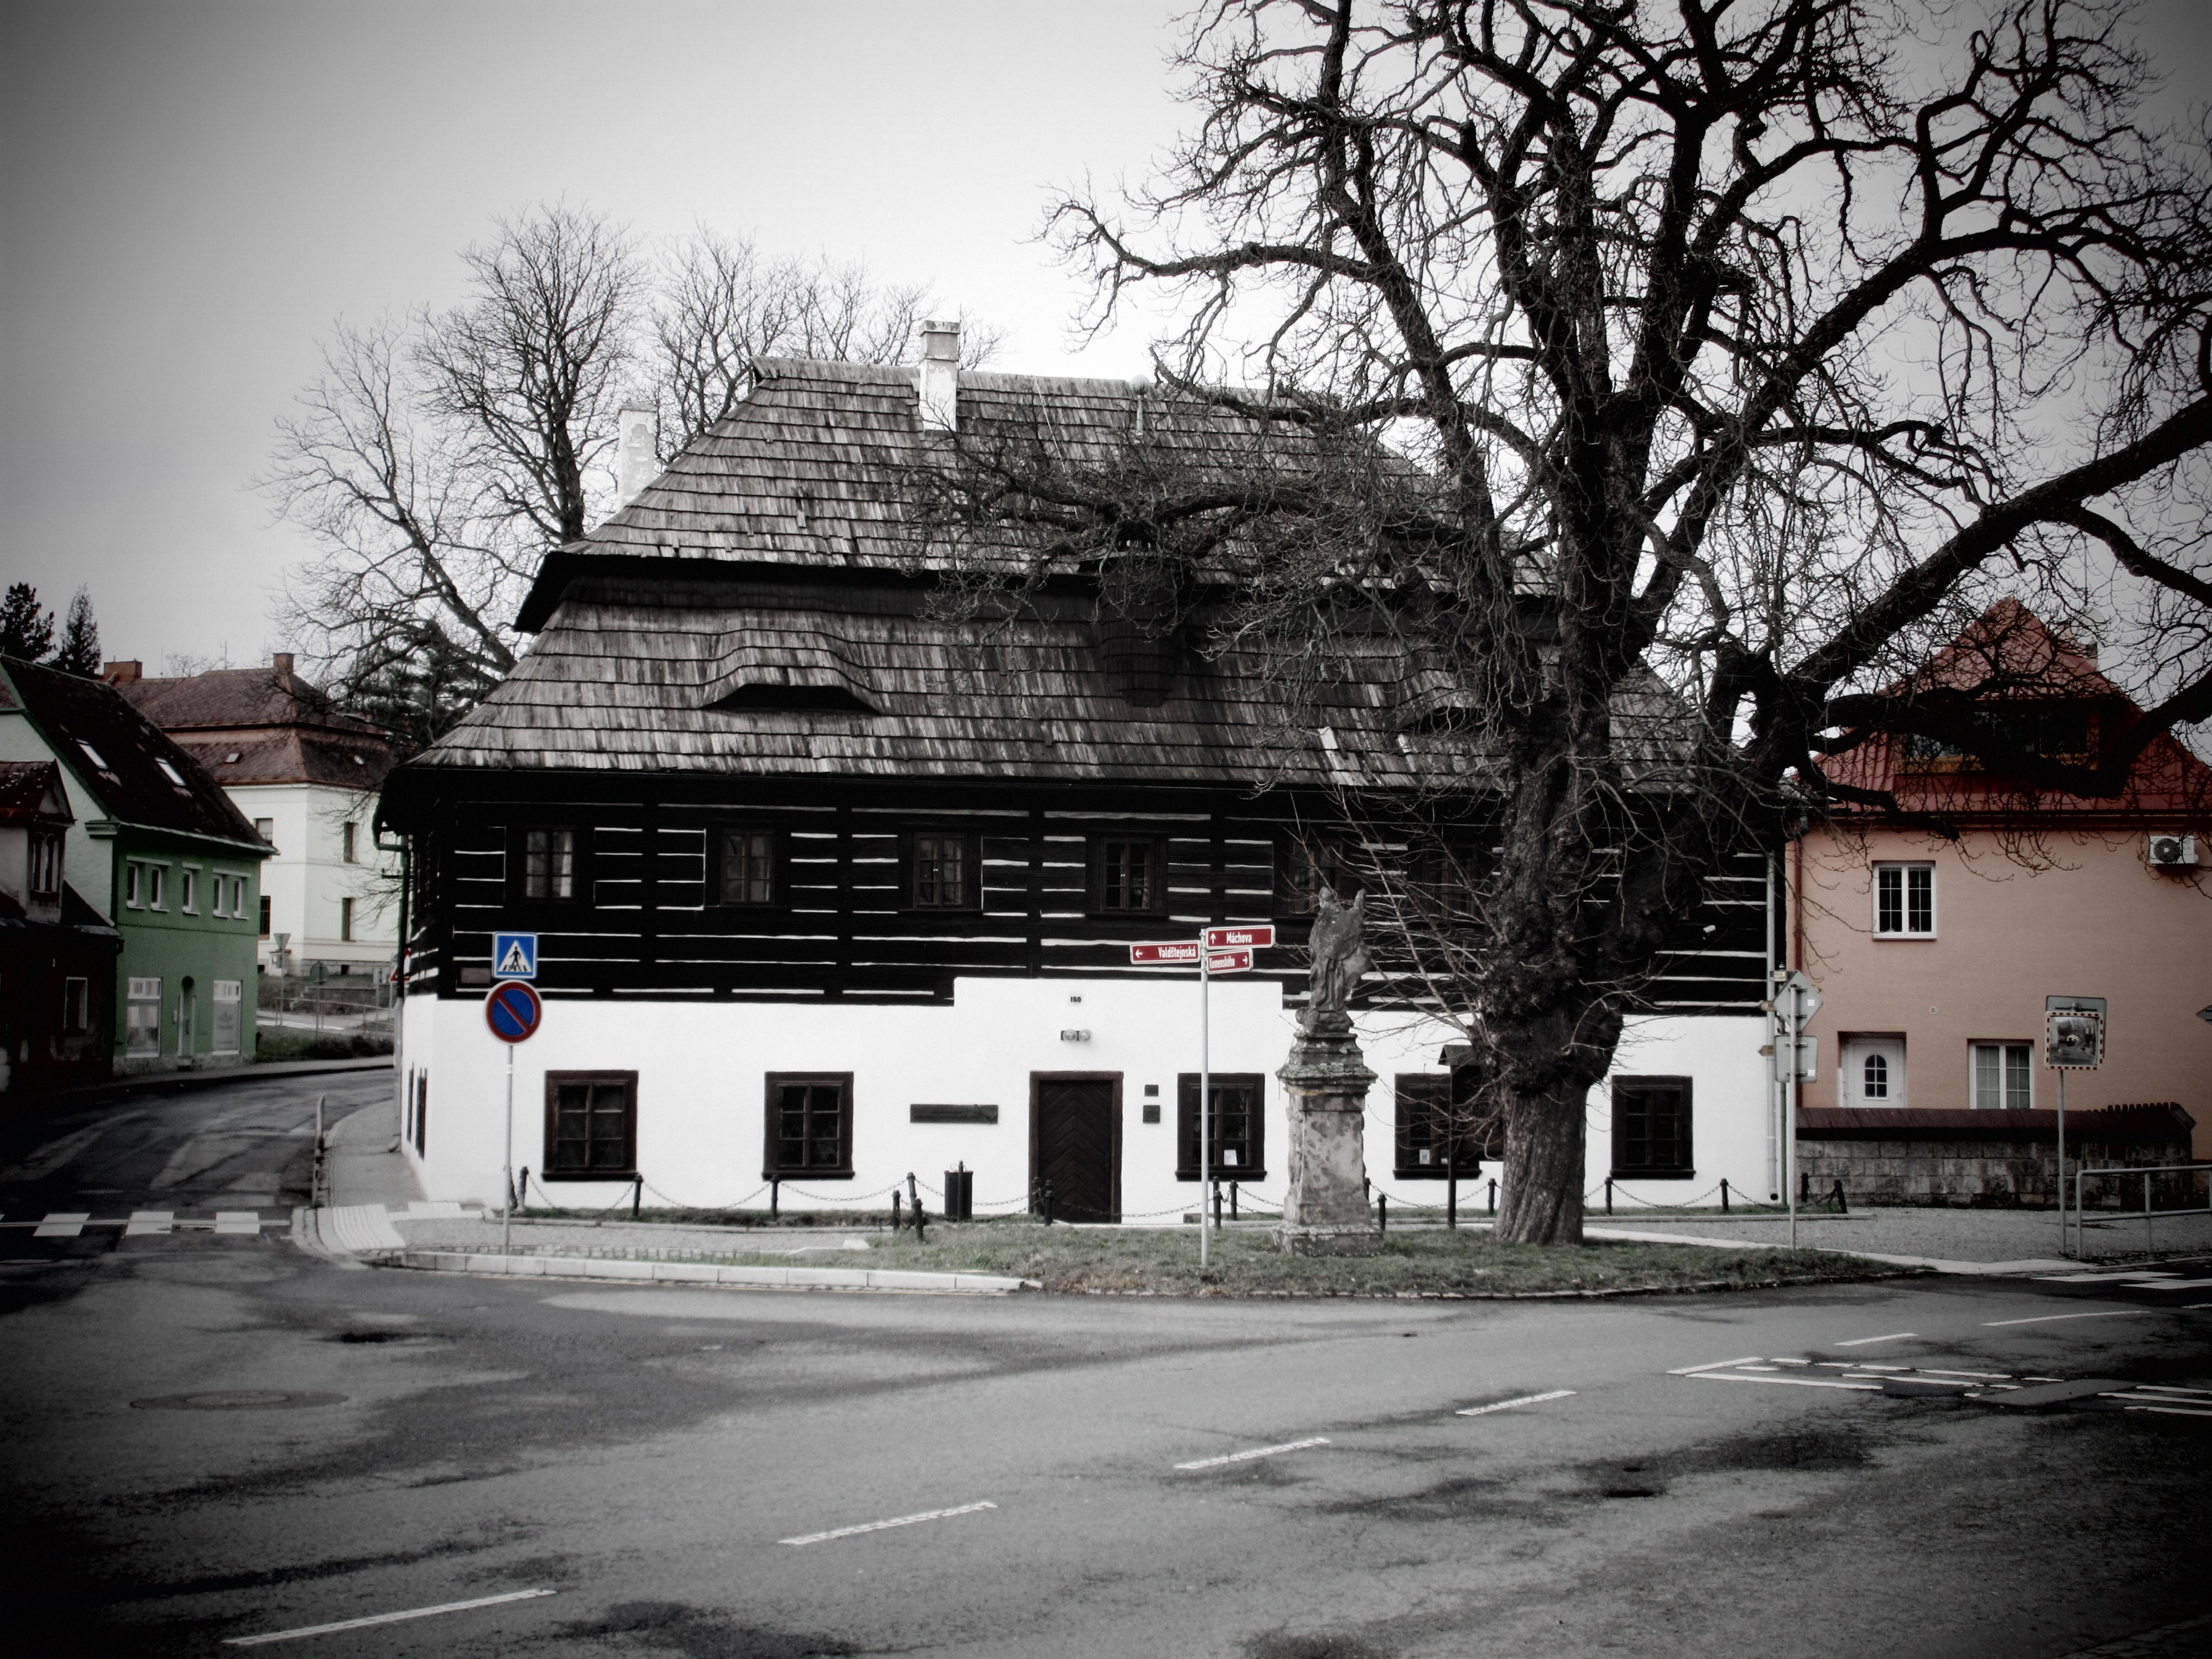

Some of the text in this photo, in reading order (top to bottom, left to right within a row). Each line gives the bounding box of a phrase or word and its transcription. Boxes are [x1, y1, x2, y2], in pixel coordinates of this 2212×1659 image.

[1227, 932, 1252, 943] Máchova
[1158, 946, 1196, 959] Valdštejnská
[1209, 956, 1235, 969] Komenského
